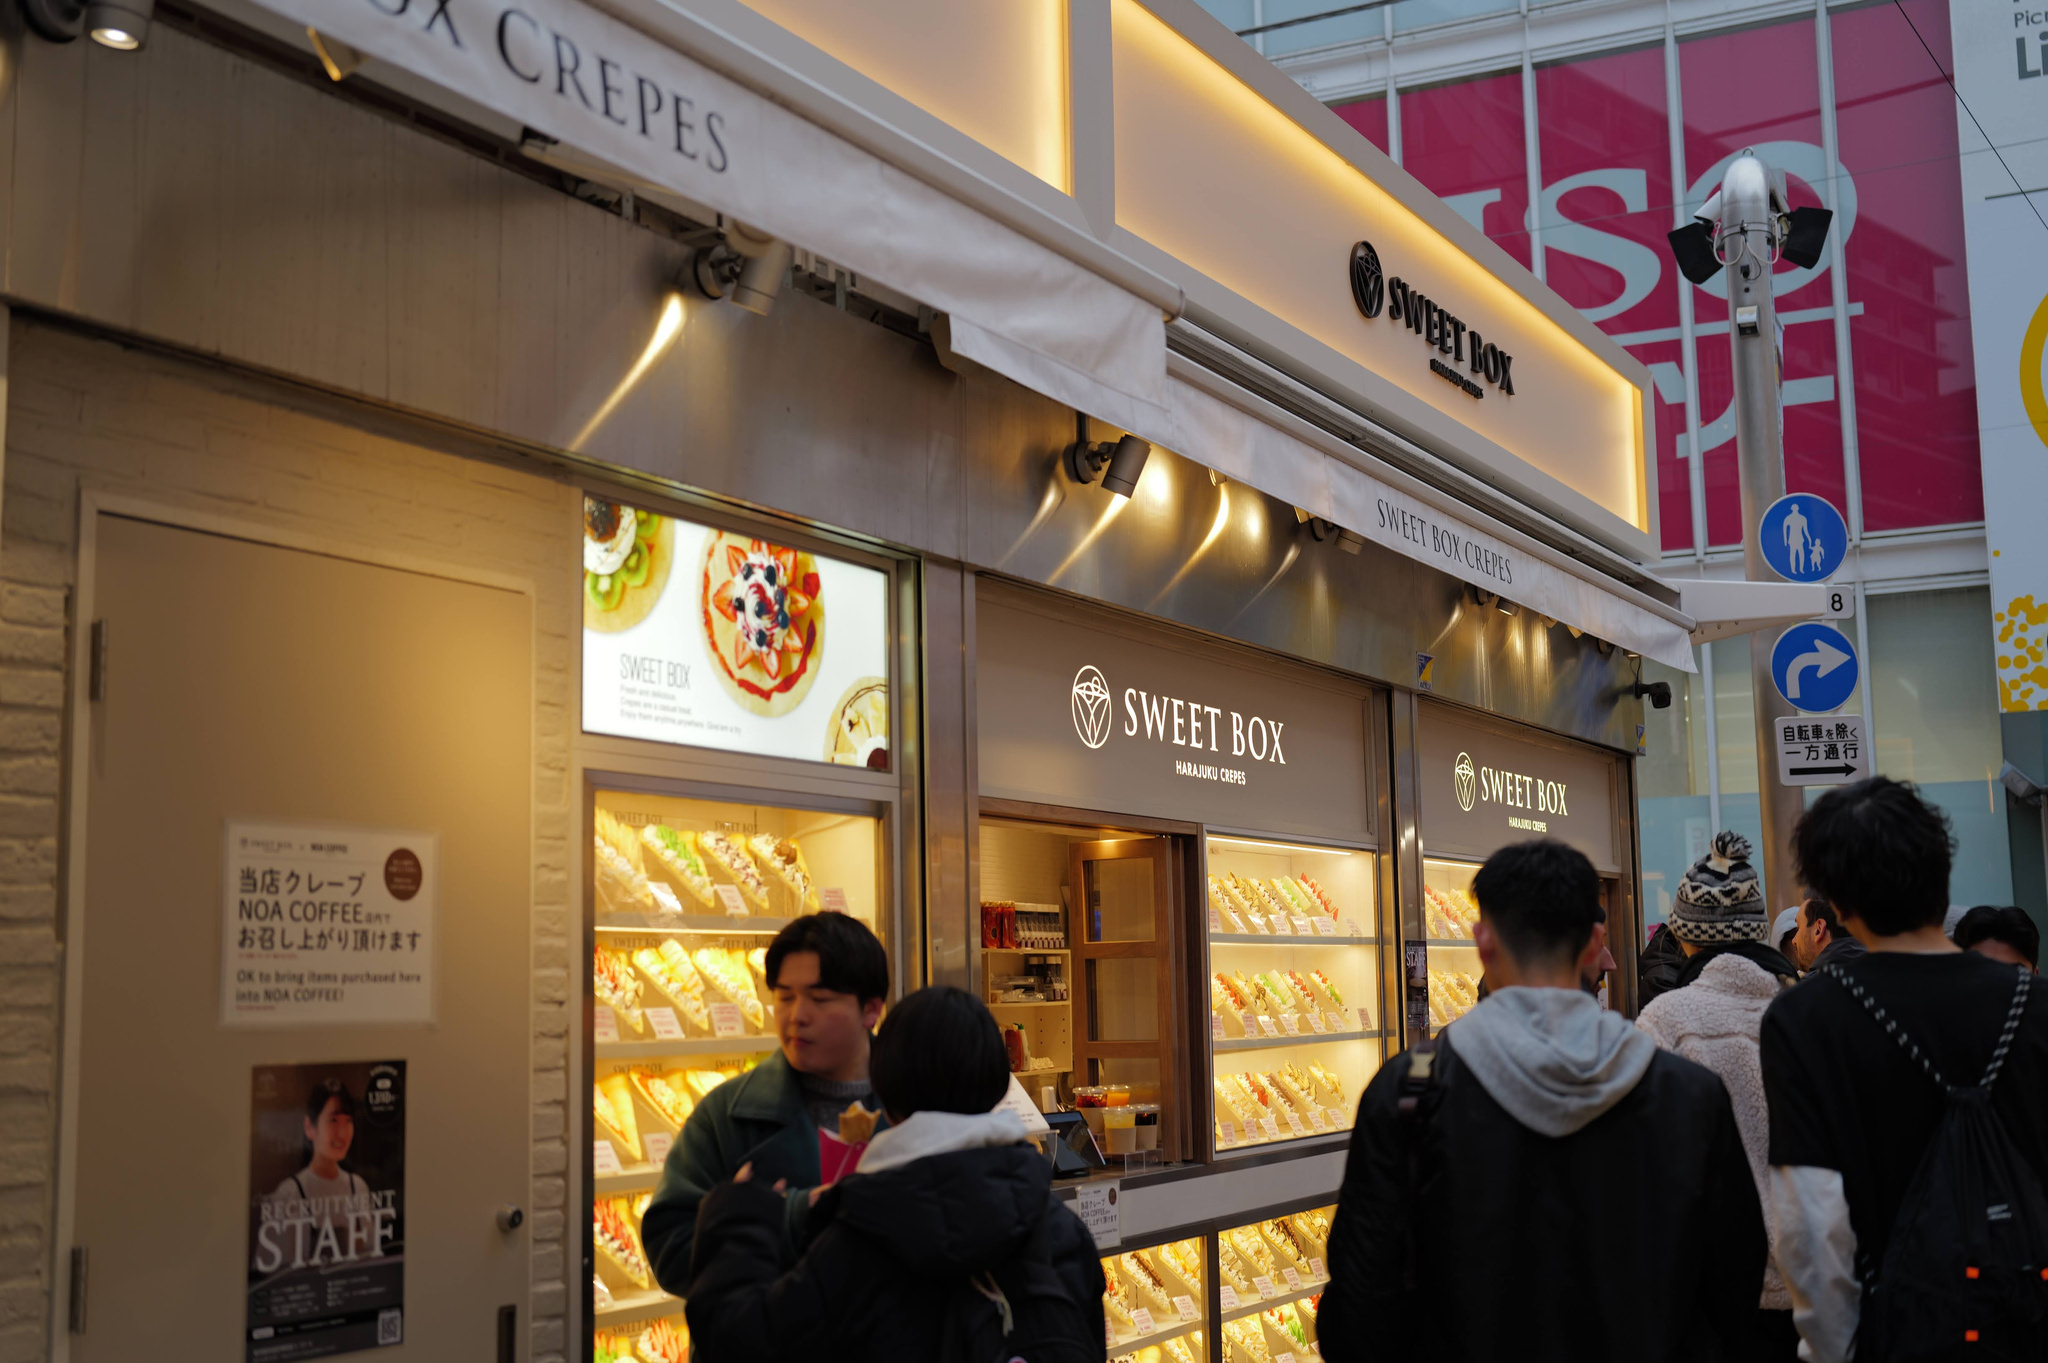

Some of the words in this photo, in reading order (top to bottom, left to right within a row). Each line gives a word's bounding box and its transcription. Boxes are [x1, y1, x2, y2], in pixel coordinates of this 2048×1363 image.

[497, 9, 728, 174] CREPES
[1389, 276, 1466, 362] SWEET
[1469, 331, 1515, 396] BOX
[1377, 498, 1426, 547] SWEET
[1432, 524, 1462, 563] BOX
[1465, 541, 1513, 584] CREPES
[1831, 593, 1843, 612] 8
[620, 653, 663, 685] SWEET
[667, 661, 691, 690] BOX
[1124, 688, 1221, 752] SWEET
[1230, 711, 1286, 765] BOX
[1783, 723, 1858, 742] 自転車を除く
[1785, 743, 1859, 761] 一方通行
[1176, 760, 1218, 781] HARAJUKU
[1220, 768, 1246, 785] CREPES
[1481, 766, 1532, 809] SWEET
[1537, 778, 1568, 816] BOX
[614, 811, 643, 824] SWEET
[1509, 816, 1532, 831] HARAJUKU
[1533, 820, 1547, 833] CREPES
[239, 866, 366, 896] 当店クレープ
[238, 899, 283, 922] NOA
[289, 900, 363, 924] COFFEE
[238, 926, 422, 952] お召し上がり頂けます
[237, 969, 255, 984] OK
[259, 970, 271, 984] to
[275, 970, 304, 986] bring
[307, 971, 338, 984] items
[341, 971, 396, 986] purchased
[399, 971, 422, 984] here
[236, 989, 260, 1003] into
[263, 989, 290, 1002] NOA
[294, 989, 344, 1003] COFFEE!
[260, 1190, 396, 1221] RECRUITMENT
[256, 1208, 397, 1274] STAFF
